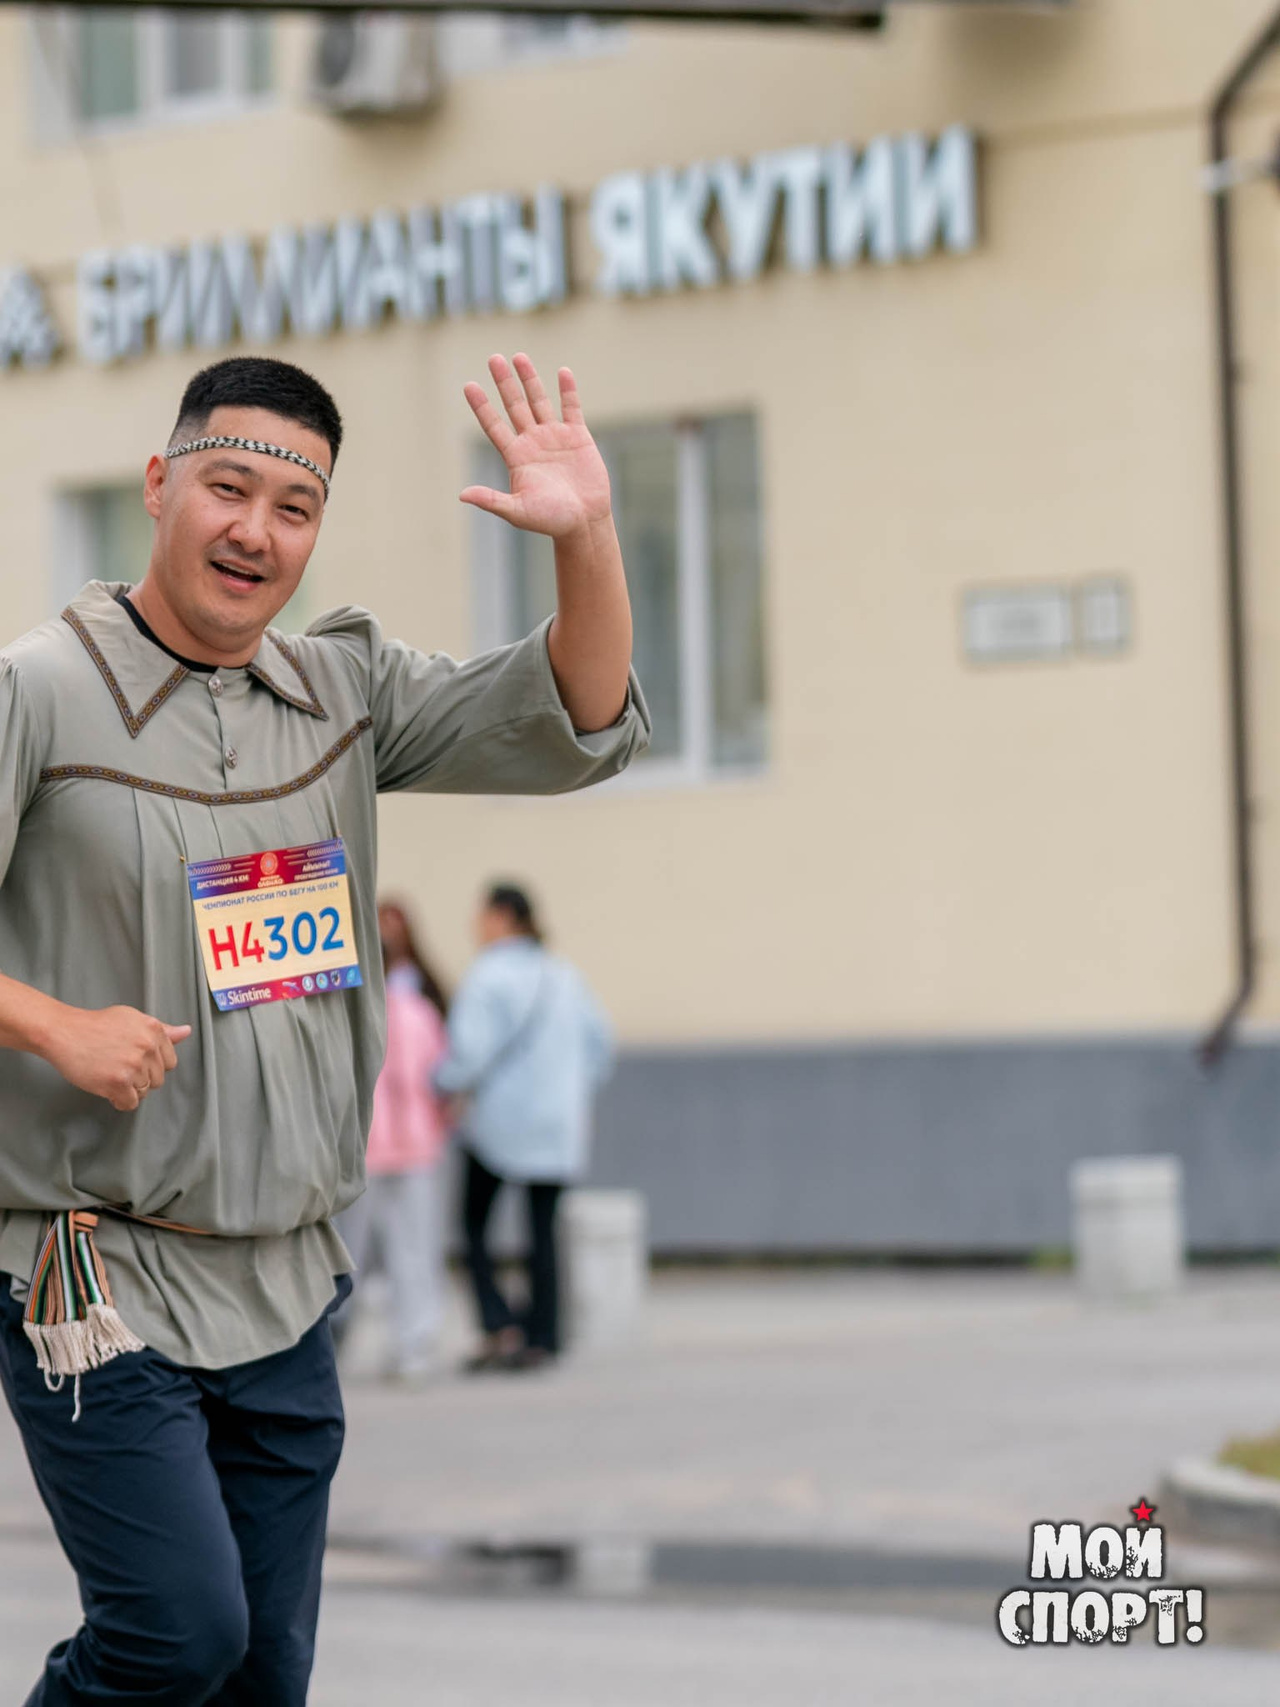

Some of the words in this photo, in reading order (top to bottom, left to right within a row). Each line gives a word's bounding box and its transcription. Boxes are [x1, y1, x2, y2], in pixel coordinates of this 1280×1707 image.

[592, 123, 980, 298] ЯКУТИИ
[196, 876, 234, 890] ДИСТАНЦИЯ
[238, 874, 250, 883] КМ
[202, 897, 246, 911] ЧЕМПИОНАТ
[246, 892, 275, 904] РОССИИ
[276, 889, 288, 899] ПО
[289, 887, 306, 897] БЕГУ
[306, 885, 317, 893] НА
[227, 986, 272, 1005] Skintime
